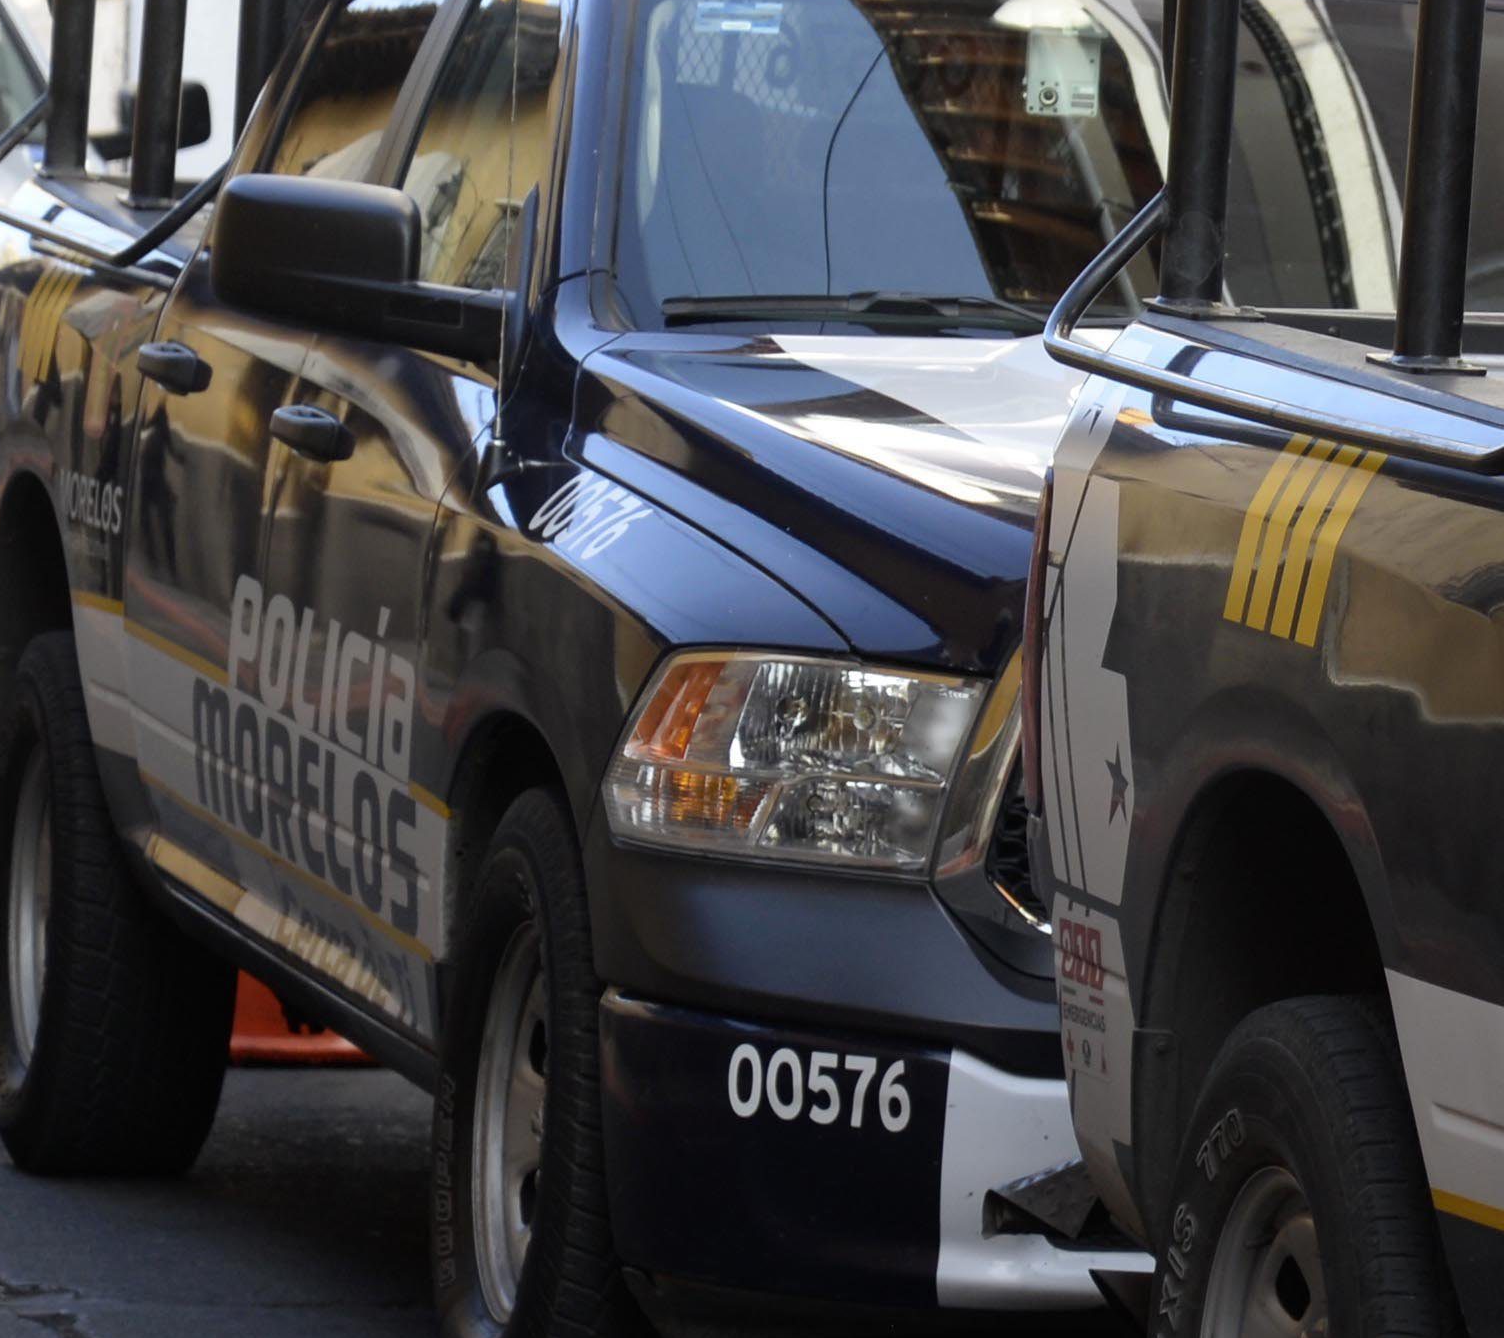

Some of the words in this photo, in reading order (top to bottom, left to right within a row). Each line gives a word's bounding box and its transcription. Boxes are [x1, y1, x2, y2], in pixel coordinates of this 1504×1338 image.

[528, 470, 653, 560] 00576
[192, 677, 419, 938] MORELOS
[1062, 1001, 1106, 1034] EMERGENCIAS
[727, 1042, 911, 1133] 00576
